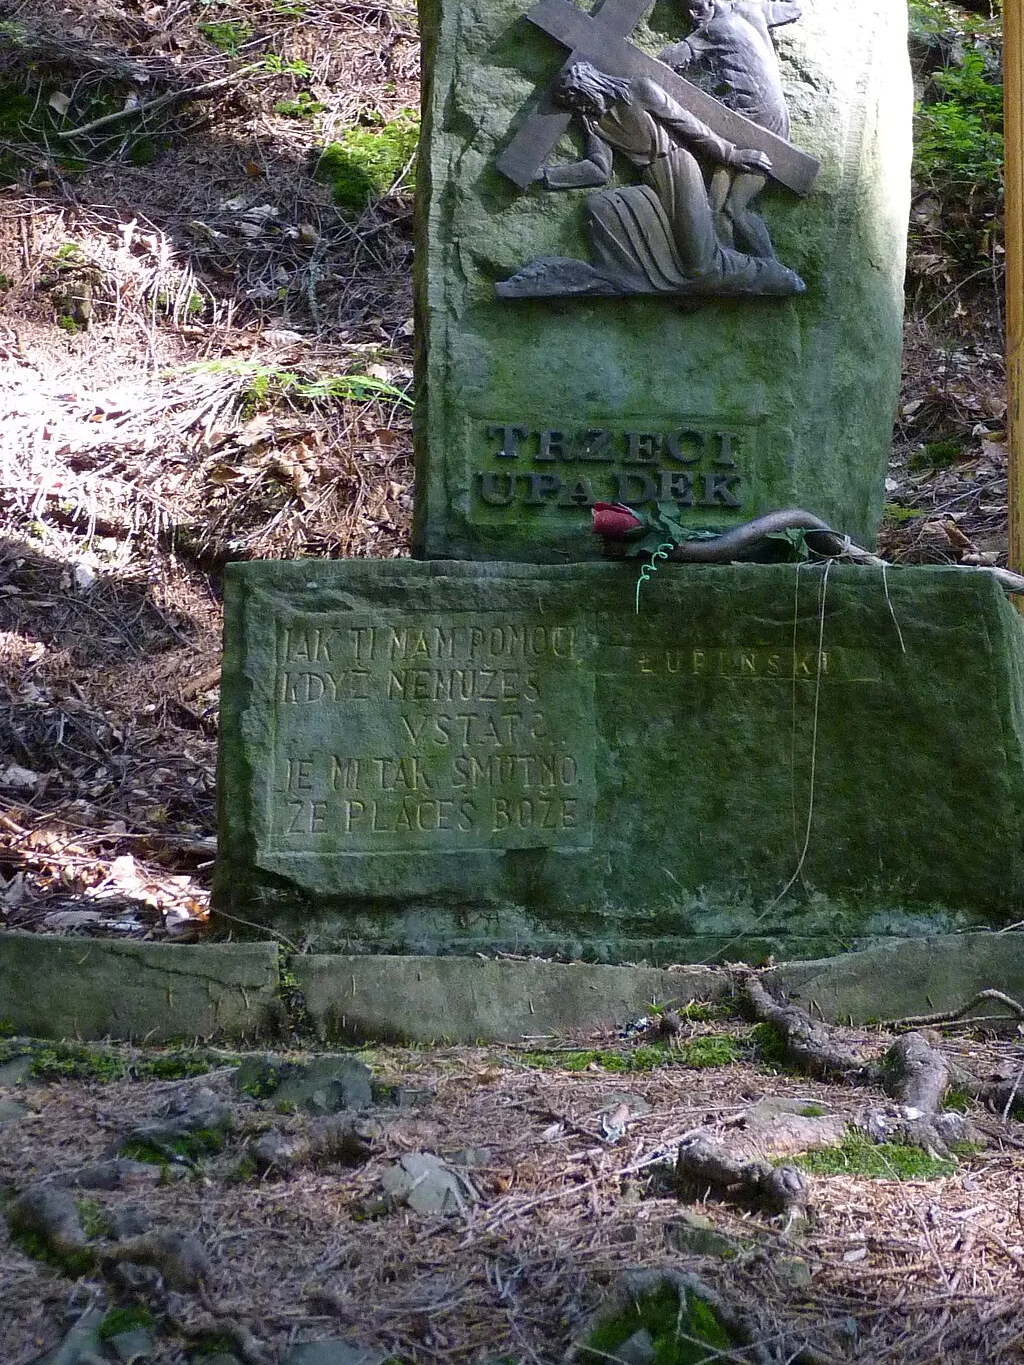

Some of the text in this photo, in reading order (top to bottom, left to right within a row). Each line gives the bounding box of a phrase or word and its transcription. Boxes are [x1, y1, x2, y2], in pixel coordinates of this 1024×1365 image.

[487, 424, 740, 469] TRZECI
[475, 470, 745, 508] UPADEK
[349, 625, 377, 661] TI
[330, 753, 363, 790] MI
[372, 755, 434, 791] TAK
